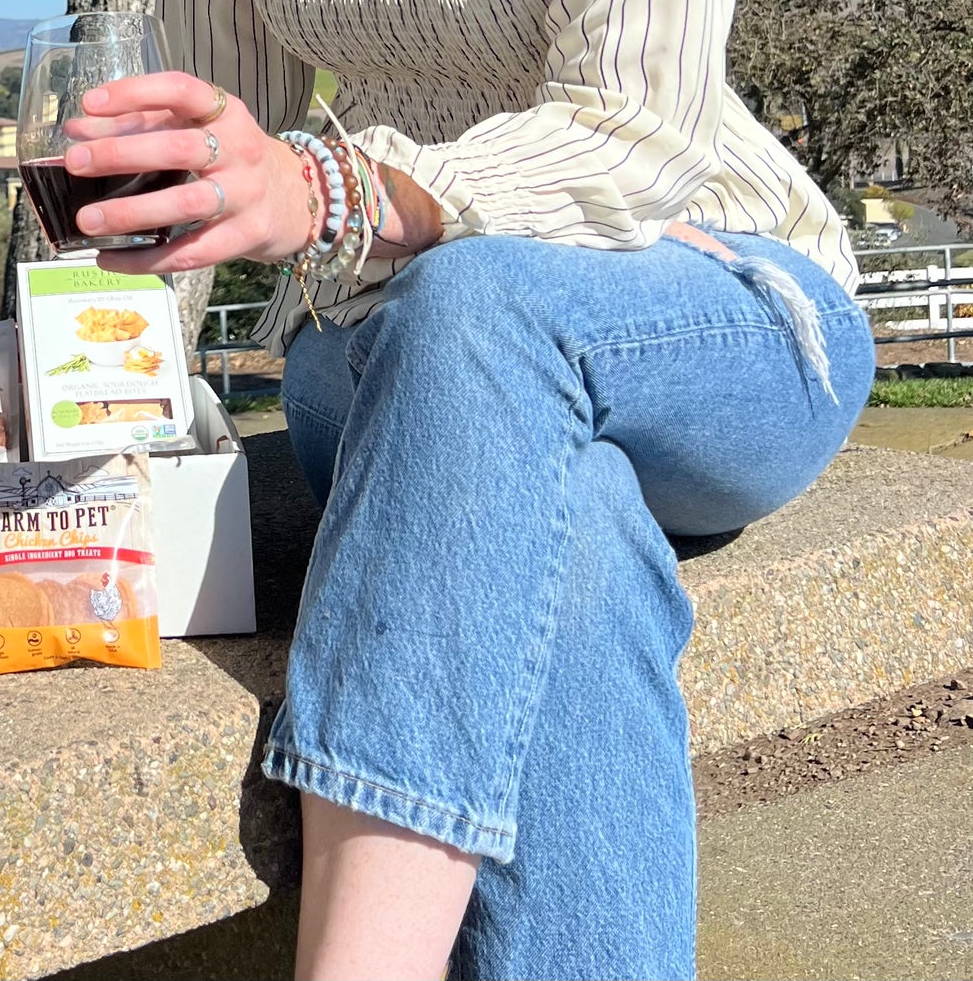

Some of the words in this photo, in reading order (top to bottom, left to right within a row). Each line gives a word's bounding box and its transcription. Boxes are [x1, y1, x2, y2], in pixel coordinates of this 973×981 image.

[73, 278, 121, 287] BAKERY
[47, 509, 69, 531] TO
[75, 505, 109, 529] PET
[3, 532, 56, 549] Chicken
[59, 529, 99, 549] Chips
[4, 552, 26, 562] SINGLE
[27, 550, 63, 560] INGREDIENT
[77, 549, 101, 557] TREATS
